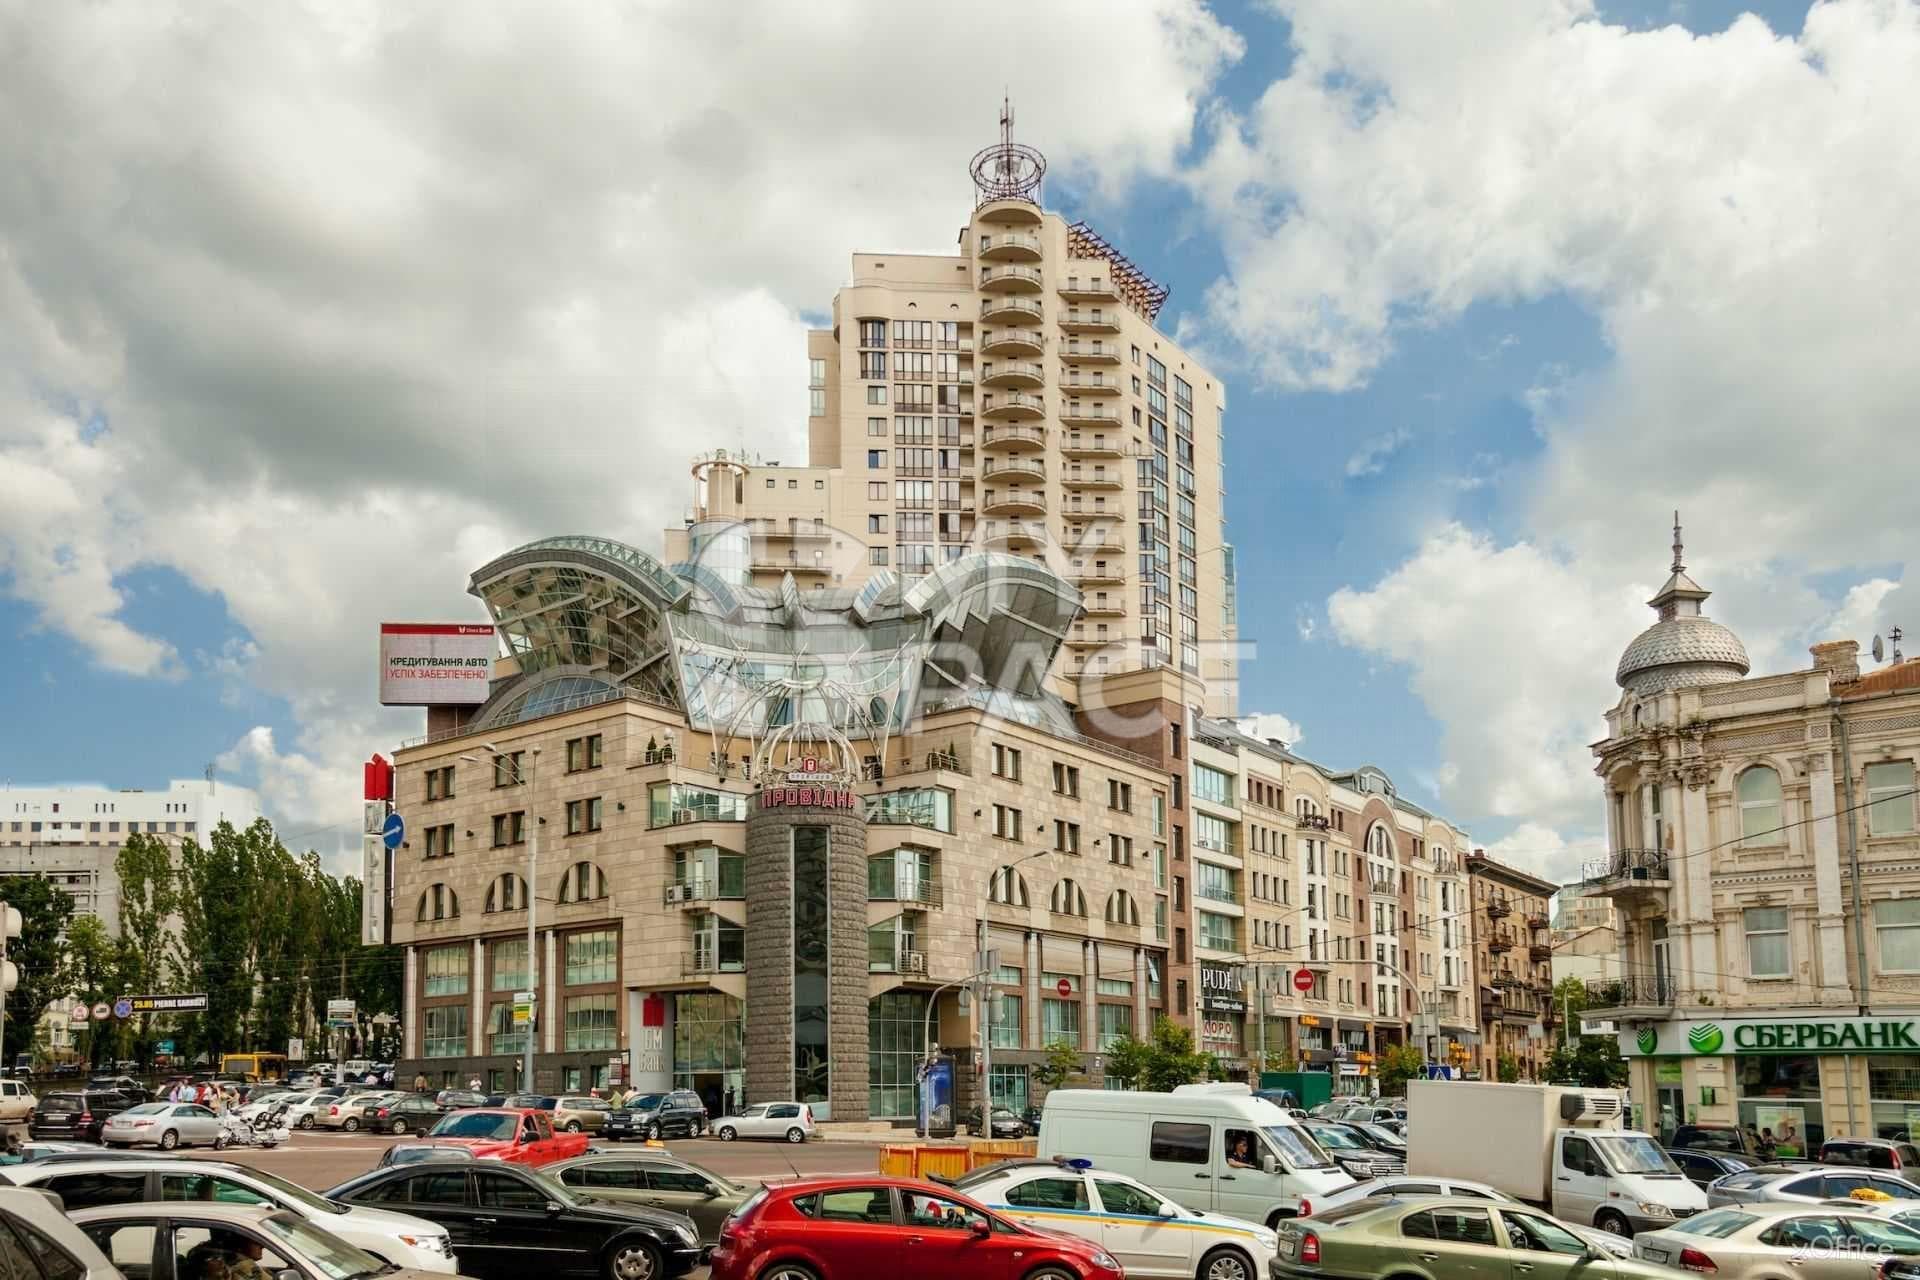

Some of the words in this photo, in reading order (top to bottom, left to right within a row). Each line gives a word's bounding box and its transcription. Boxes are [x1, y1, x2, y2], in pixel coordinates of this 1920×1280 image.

[390, 656, 463, 667] КРЕДИТУВАННЯ
[465, 656, 488, 667] АВТО
[390, 668, 416, 679] УСПІХ
[762, 786, 857, 809] ПРОВІДНА
[1733, 1021, 1919, 1048] СБЕРБАНК
